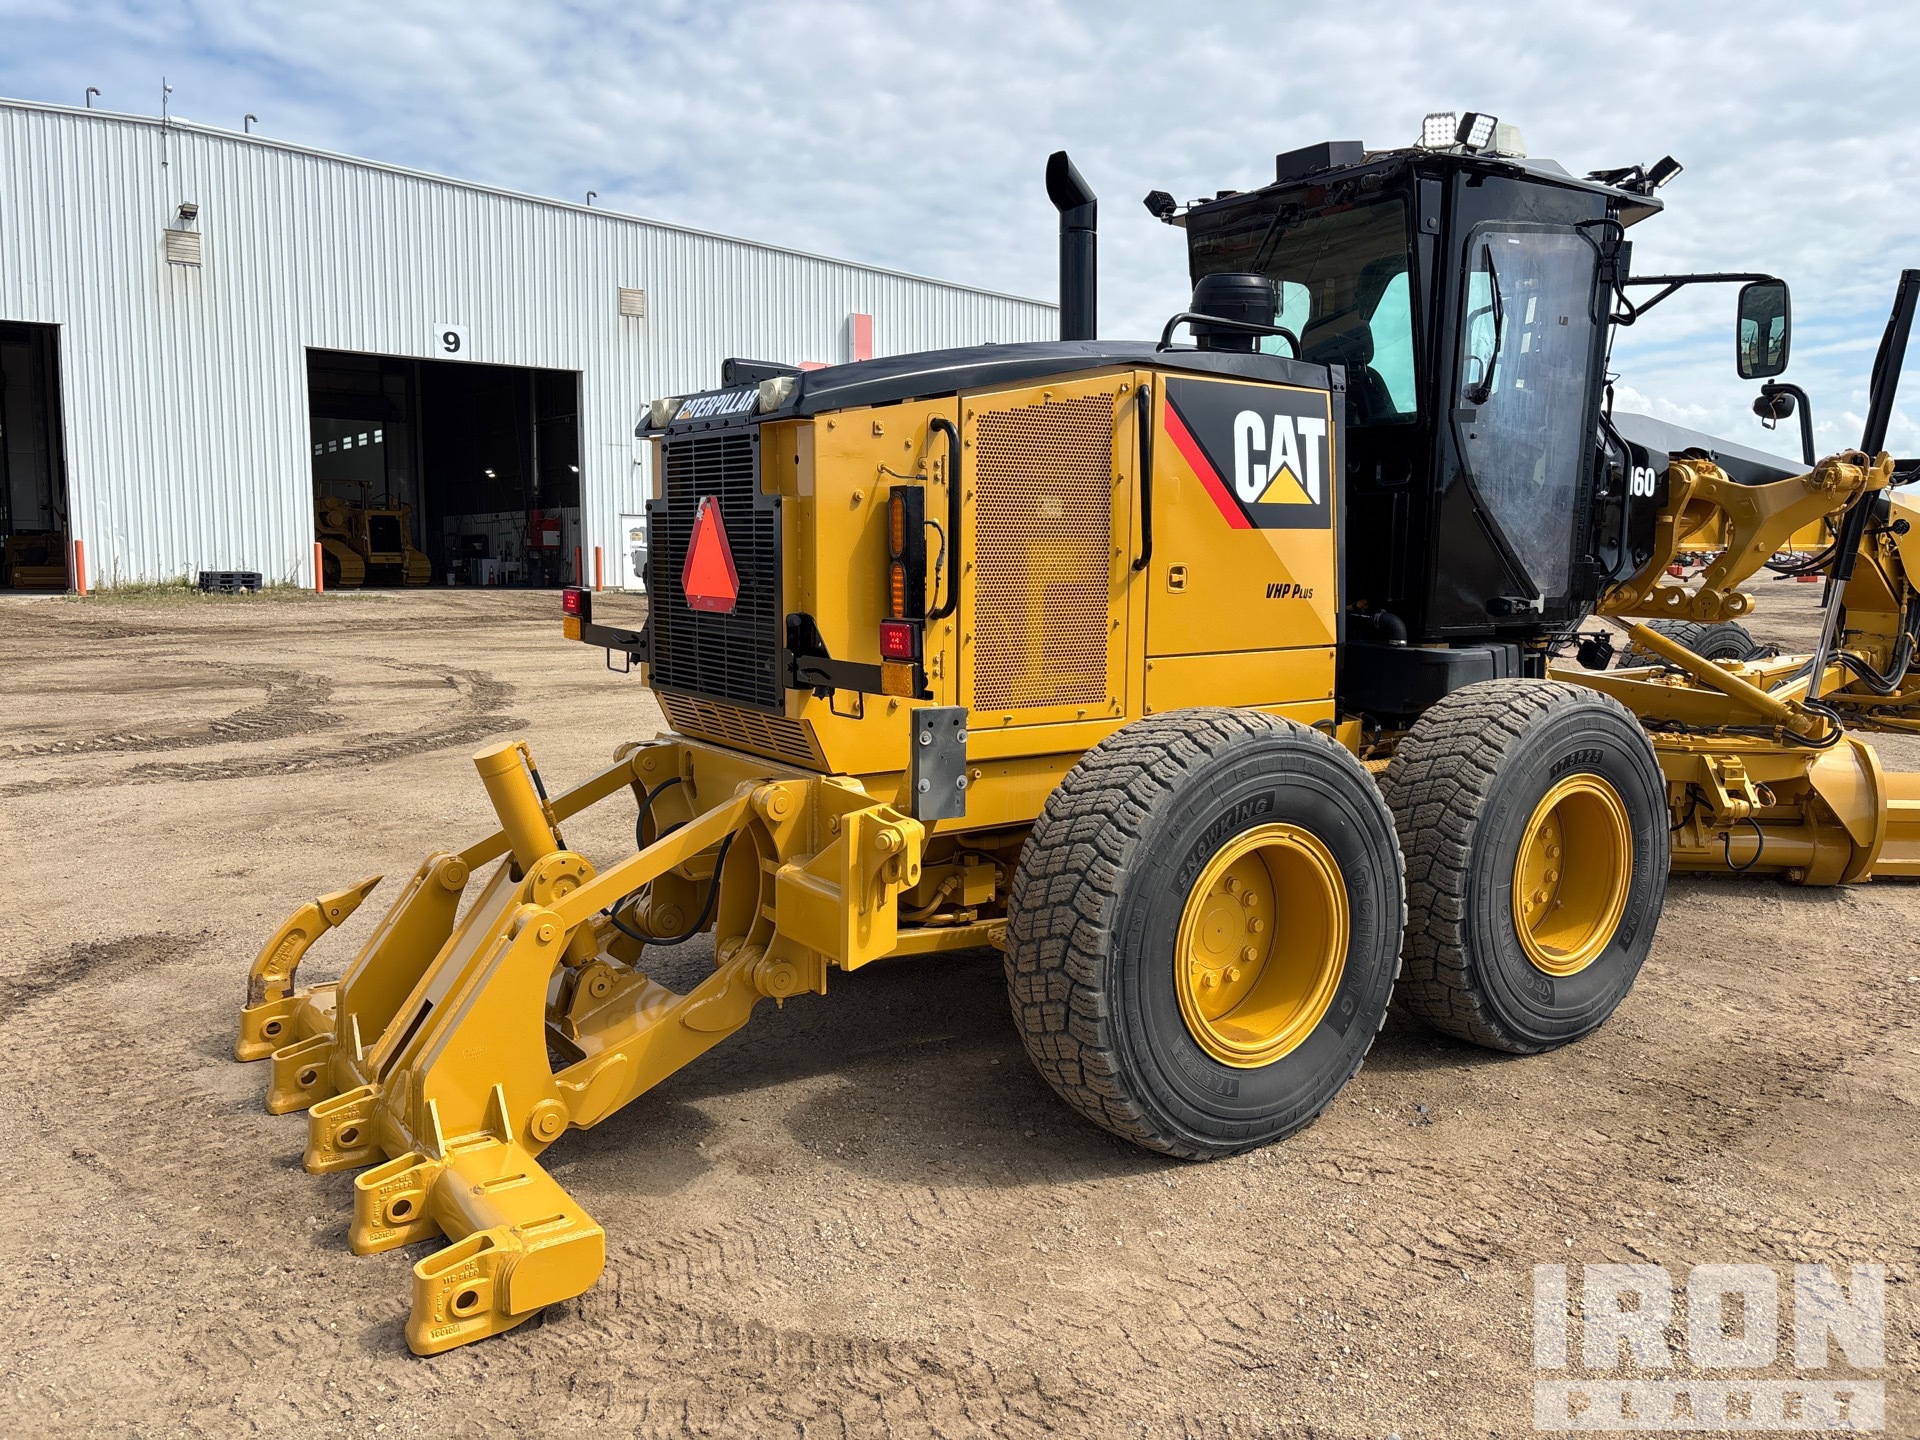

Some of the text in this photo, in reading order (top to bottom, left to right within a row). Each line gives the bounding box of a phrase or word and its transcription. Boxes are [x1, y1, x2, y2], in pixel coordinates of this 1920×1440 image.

[443, 331, 461, 353] 9
[675, 388, 760, 420] CATERPILLAR
[1234, 410, 1326, 505] CAT
[1629, 466, 1655, 497] 160
[1266, 583, 1291, 599] VHP
[1179, 798, 1268, 889] SNOWKING
